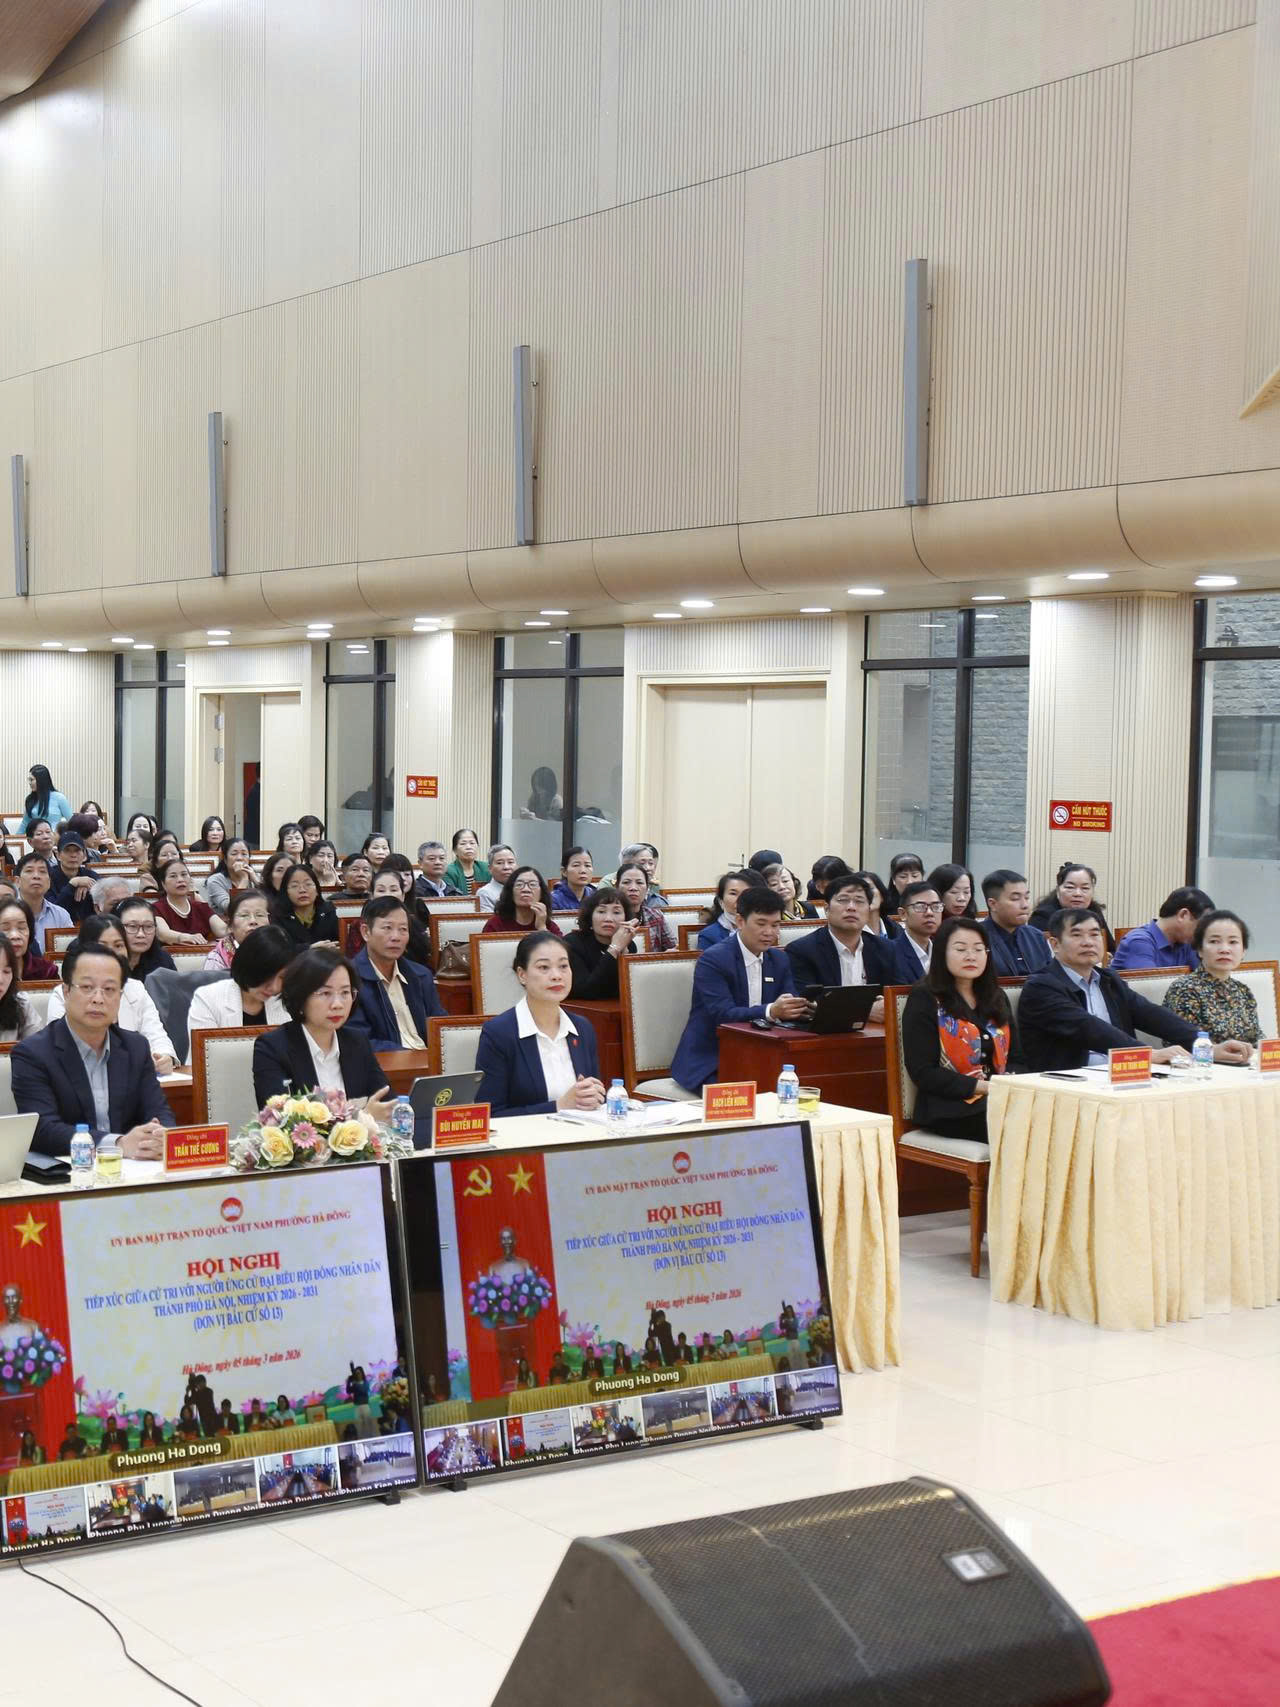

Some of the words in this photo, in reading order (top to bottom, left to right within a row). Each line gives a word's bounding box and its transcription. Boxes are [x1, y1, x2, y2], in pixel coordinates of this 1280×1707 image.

[646, 1205, 677, 1224] HỘI
[680, 1200, 722, 1218] NGHỊ
[125, 1235, 144, 1246] BAN
[253, 1219, 273, 1231] NAM
[186, 1257, 225, 1279] HỘI
[228, 1250, 280, 1273] NGHỊ
[163, 1286, 177, 1300] TRI
[595, 1377, 635, 1392] Phuong
[636, 1374, 651, 1385] Ha
[653, 1370, 680, 1384] Dong
[117, 1450, 166, 1467] Phuong
[168, 1446, 186, 1459] Ha
[189, 1442, 222, 1456] Dong
